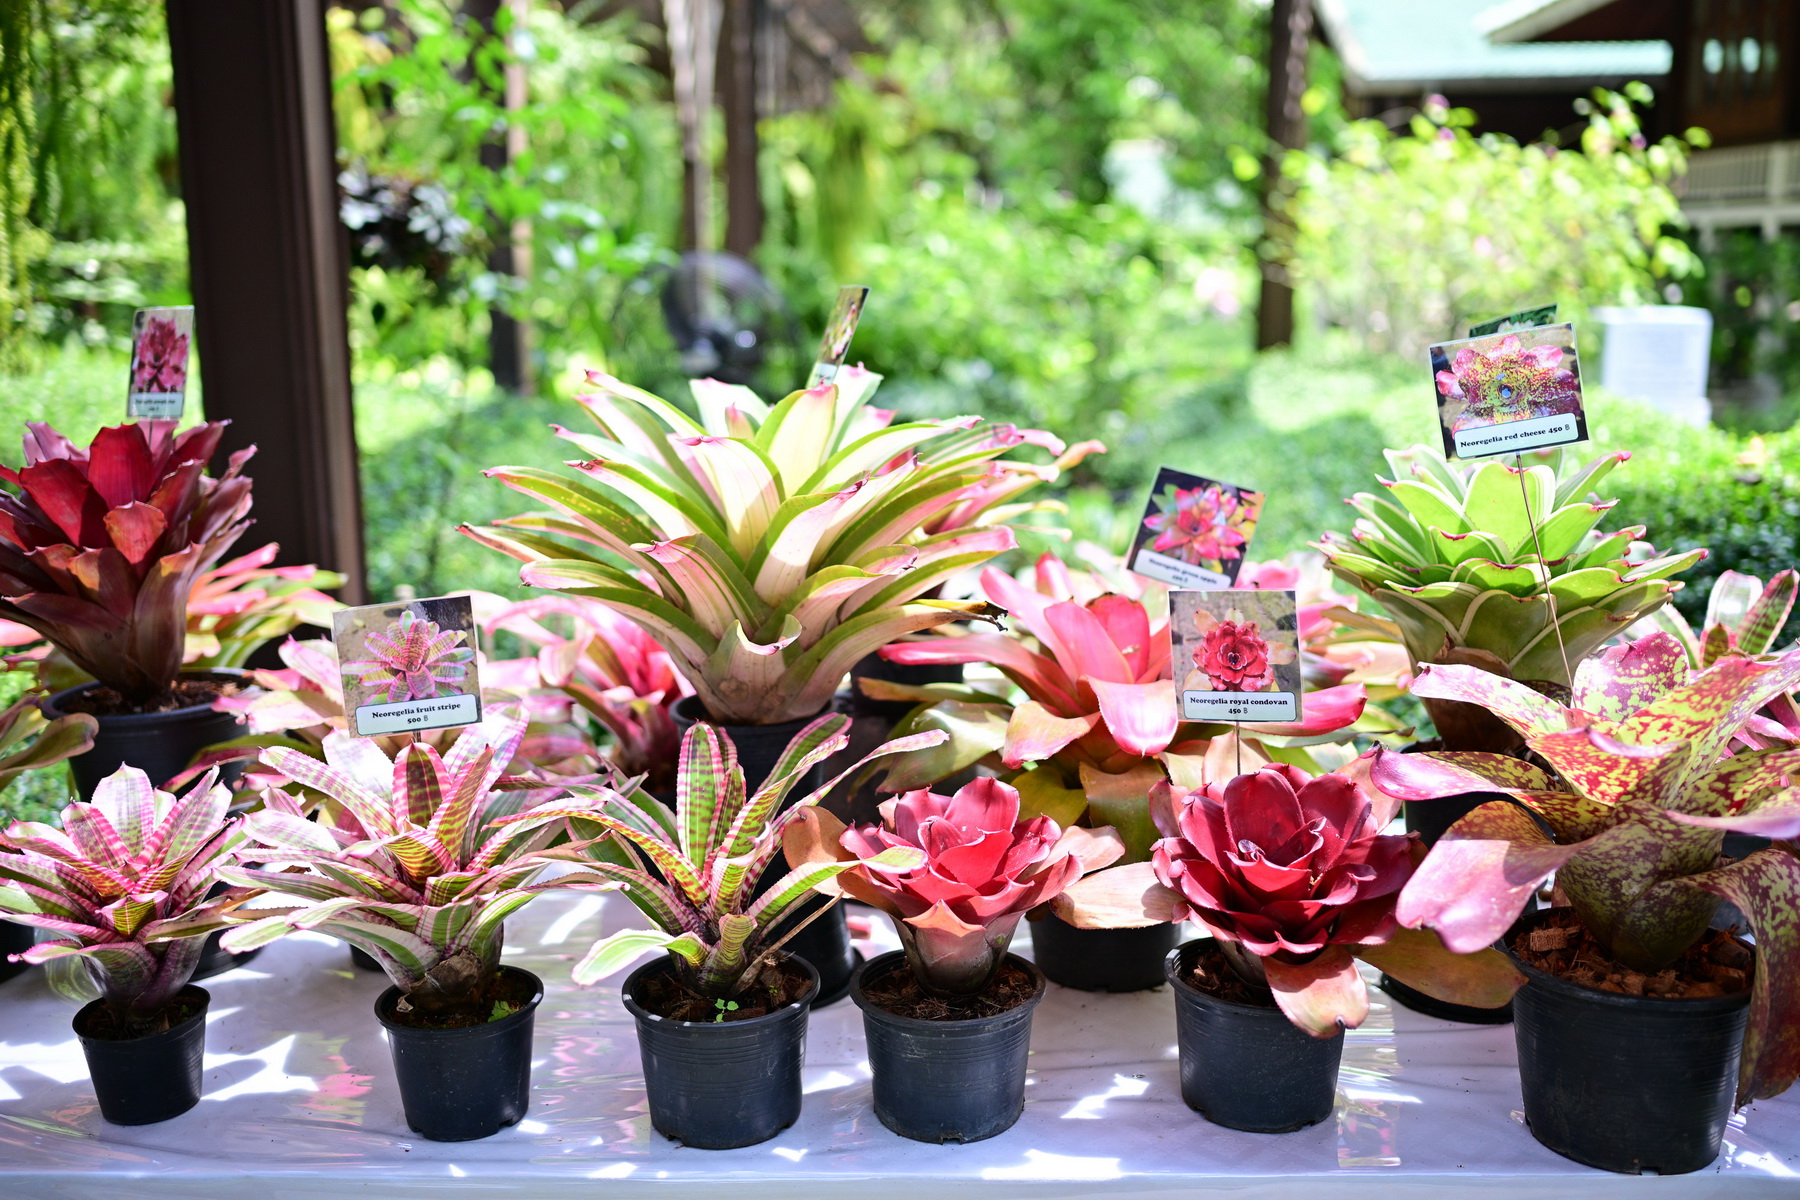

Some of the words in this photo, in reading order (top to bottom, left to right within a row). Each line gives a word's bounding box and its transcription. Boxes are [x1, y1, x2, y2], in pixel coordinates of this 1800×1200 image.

[1460, 436, 1503, 448] Neoregelia
[1504, 433, 1518, 441] red
[1519, 428, 1546, 438] cheese
[1548, 426, 1563, 434] 450
[1190, 697, 1228, 706] Neoregelia
[1229, 698, 1249, 706] royal
[372, 708, 415, 719] Neoregelia
[416, 705, 436, 714] fruit
[437, 702, 461, 712] stripe
[407, 717, 421, 725] 500
